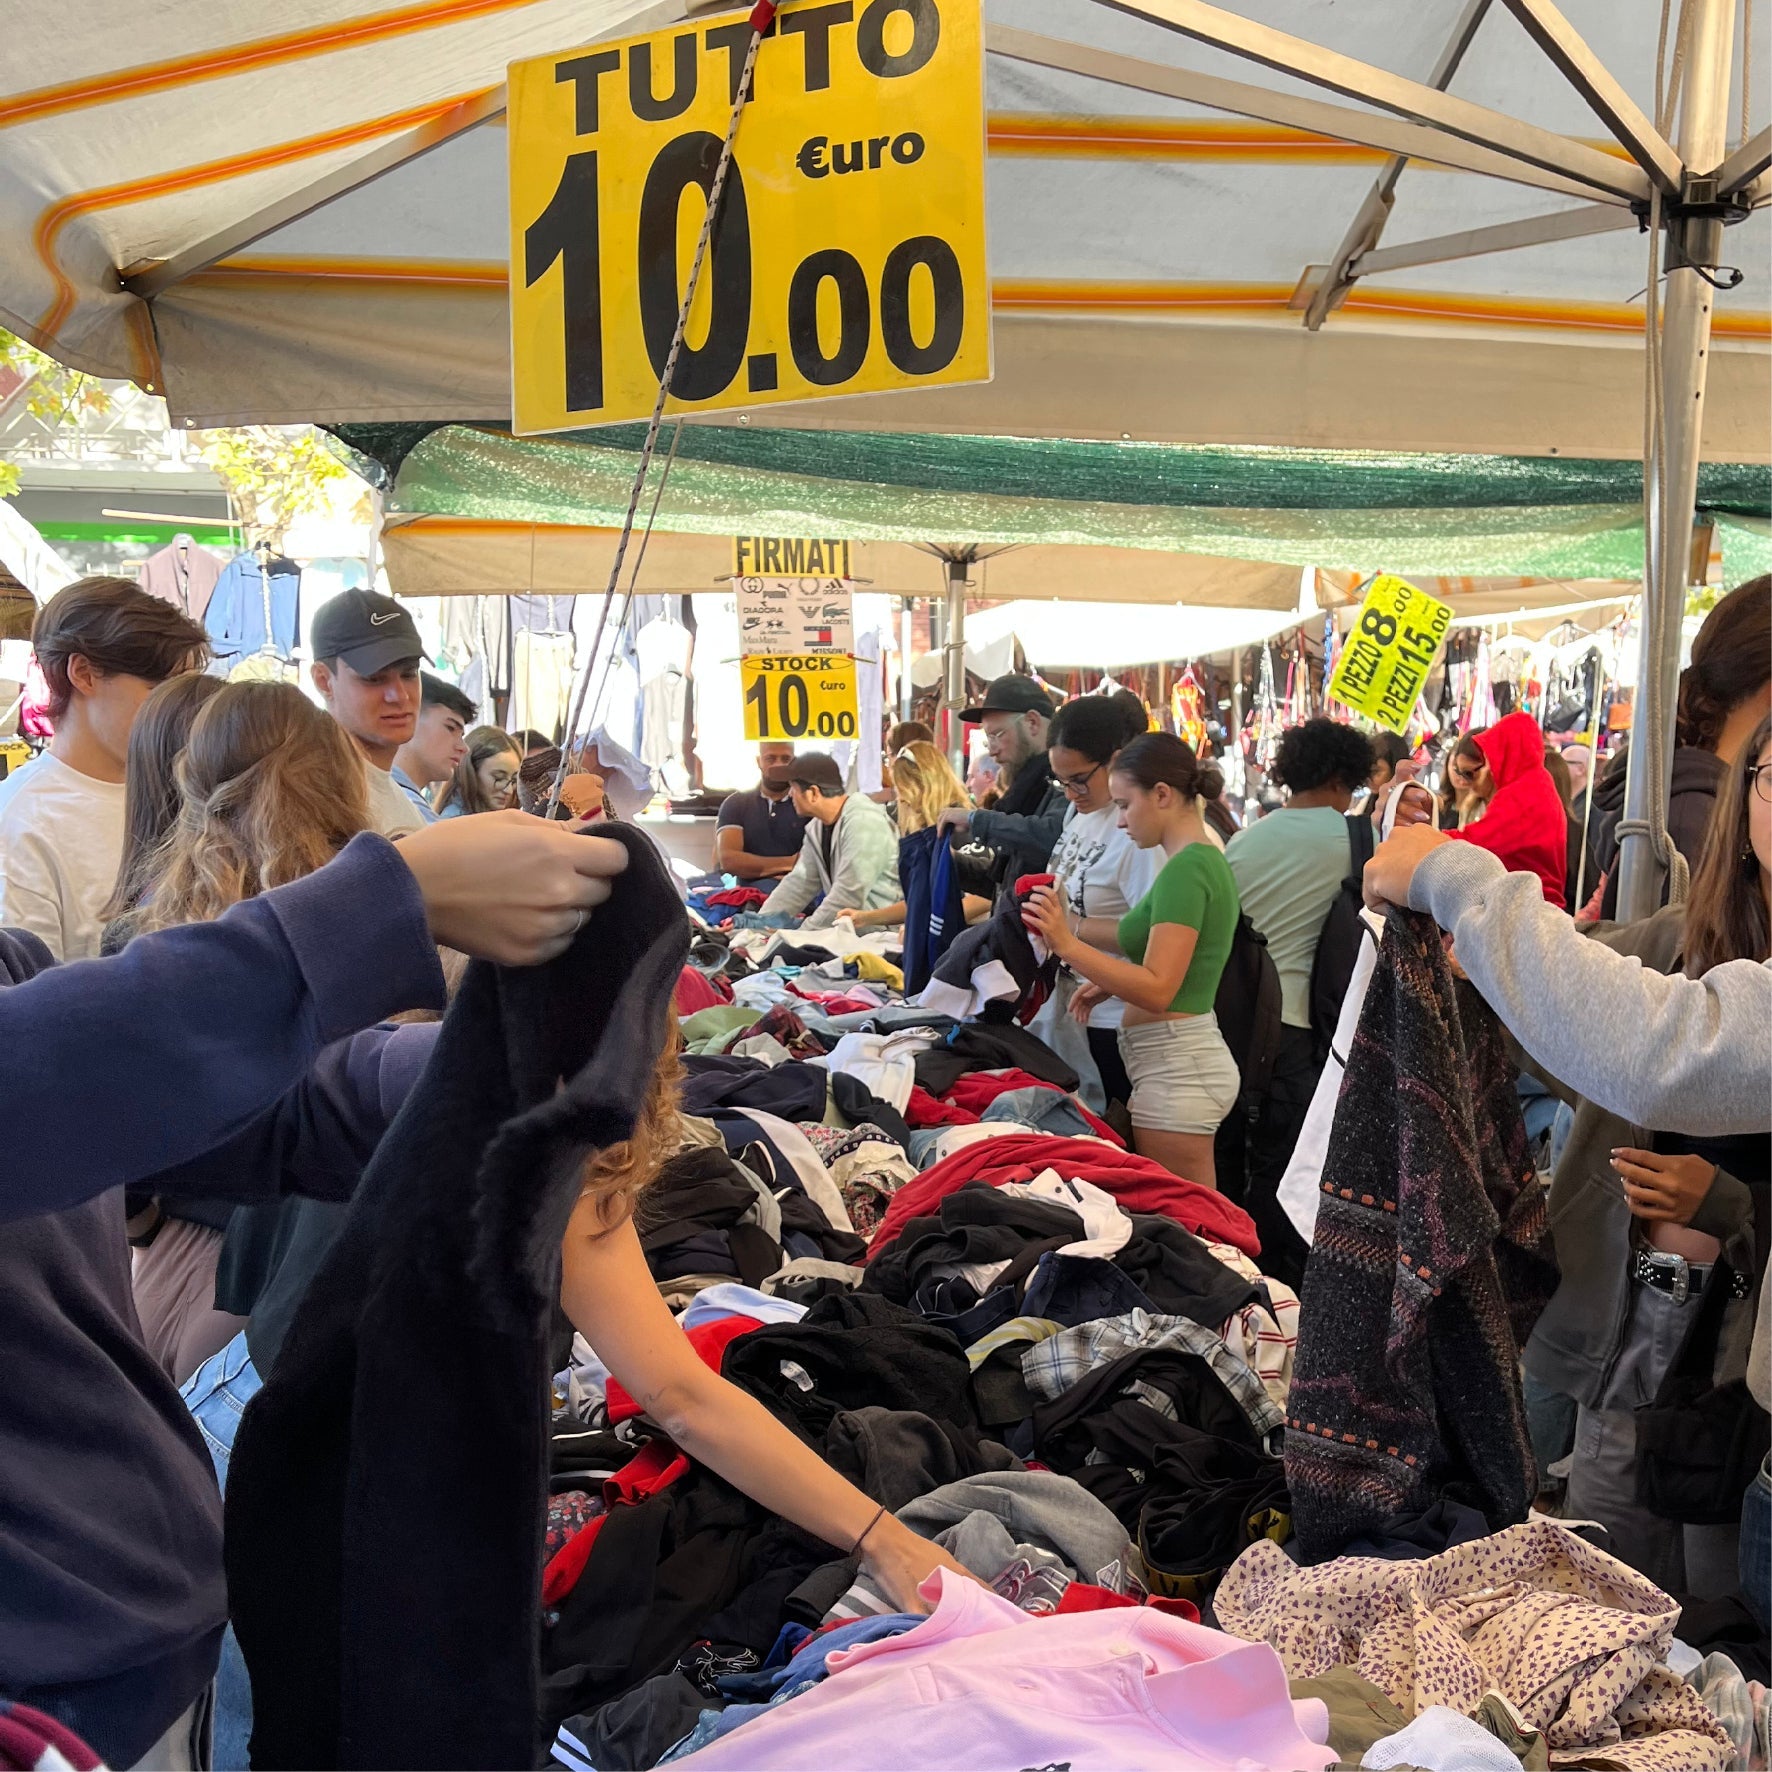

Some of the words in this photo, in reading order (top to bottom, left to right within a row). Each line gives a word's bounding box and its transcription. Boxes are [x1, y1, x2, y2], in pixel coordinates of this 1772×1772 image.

[555, 0, 940, 136] TUTTO
[795, 132, 925, 178] €uro
[525, 131, 964, 412] 10.00
[737, 536, 849, 575] FIRMATI
[1361, 586, 1412, 646] 8.00
[1397, 607, 1451, 667] 15.00
[761, 657, 833, 670] STOCK
[1341, 640, 1382, 695] PEZZO
[1382, 661, 1420, 714] PEZZI
[746, 674, 855, 737] 10.00
[1336, 688, 1363, 704] 1
[1377, 709, 1400, 727] 2
